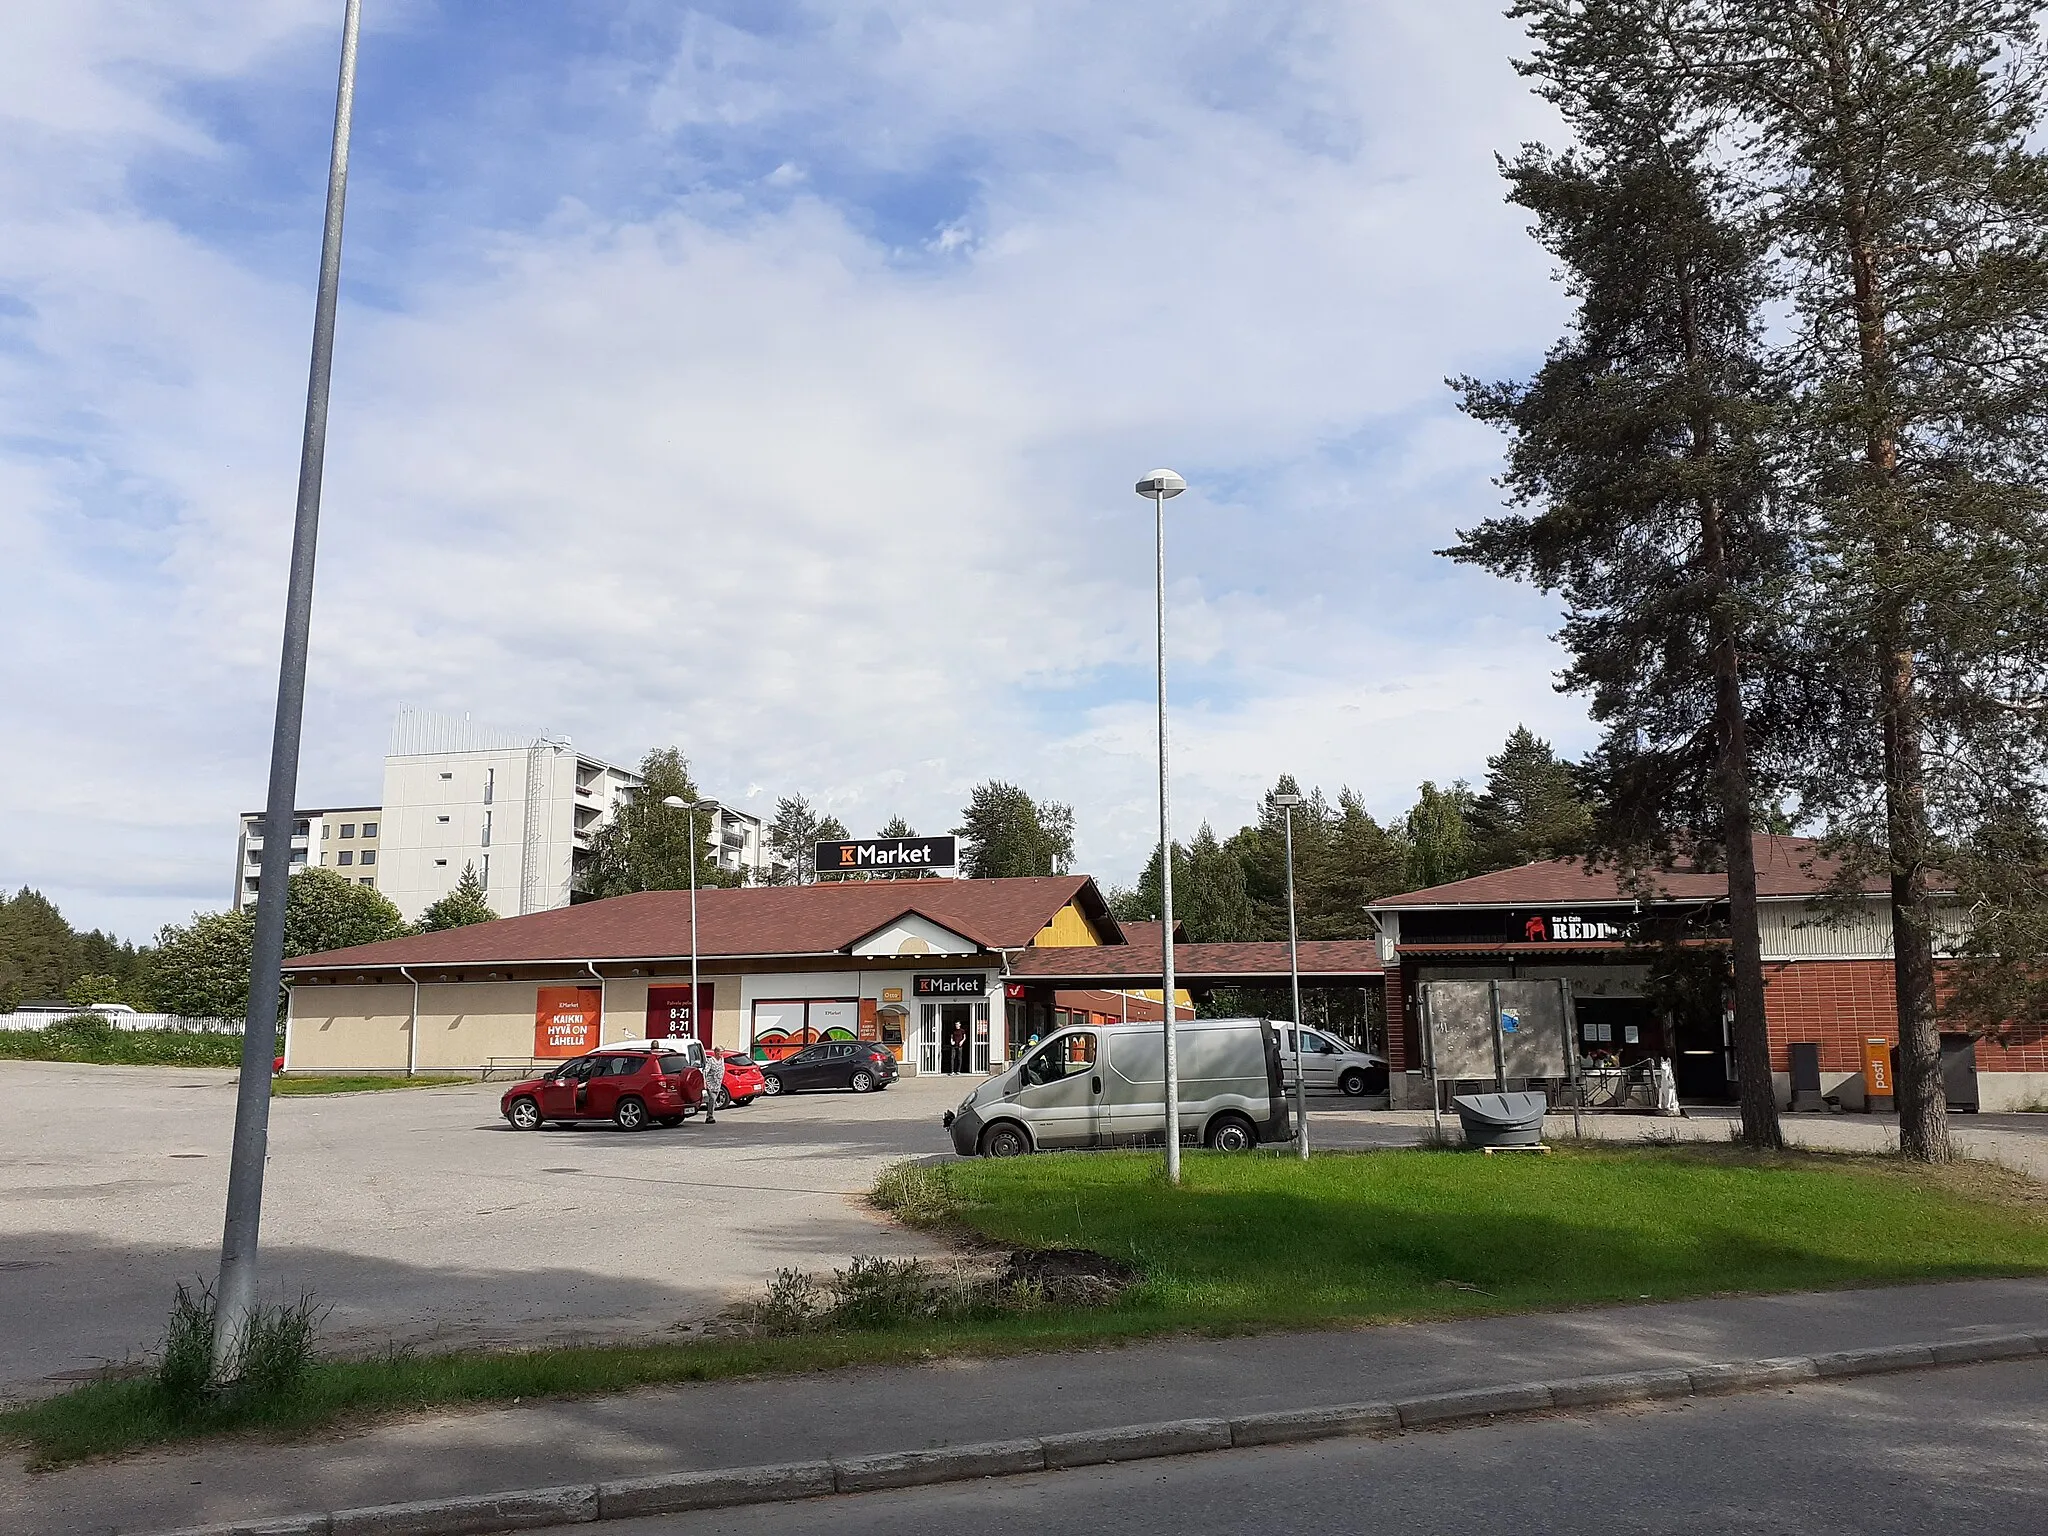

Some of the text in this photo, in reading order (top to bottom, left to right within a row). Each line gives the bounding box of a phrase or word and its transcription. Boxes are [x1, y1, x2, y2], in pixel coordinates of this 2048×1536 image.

[553, 1014, 583, 1024] KAIKKI
[670, 1008, 689, 1019] 8-21
[547, 1024, 588, 1035] HYVÄ ON
[669, 1020, 689, 1032] 8-21
[549, 1034, 585, 1046] LÄHELLÄ
[1871, 1060, 1889, 1089] posti
